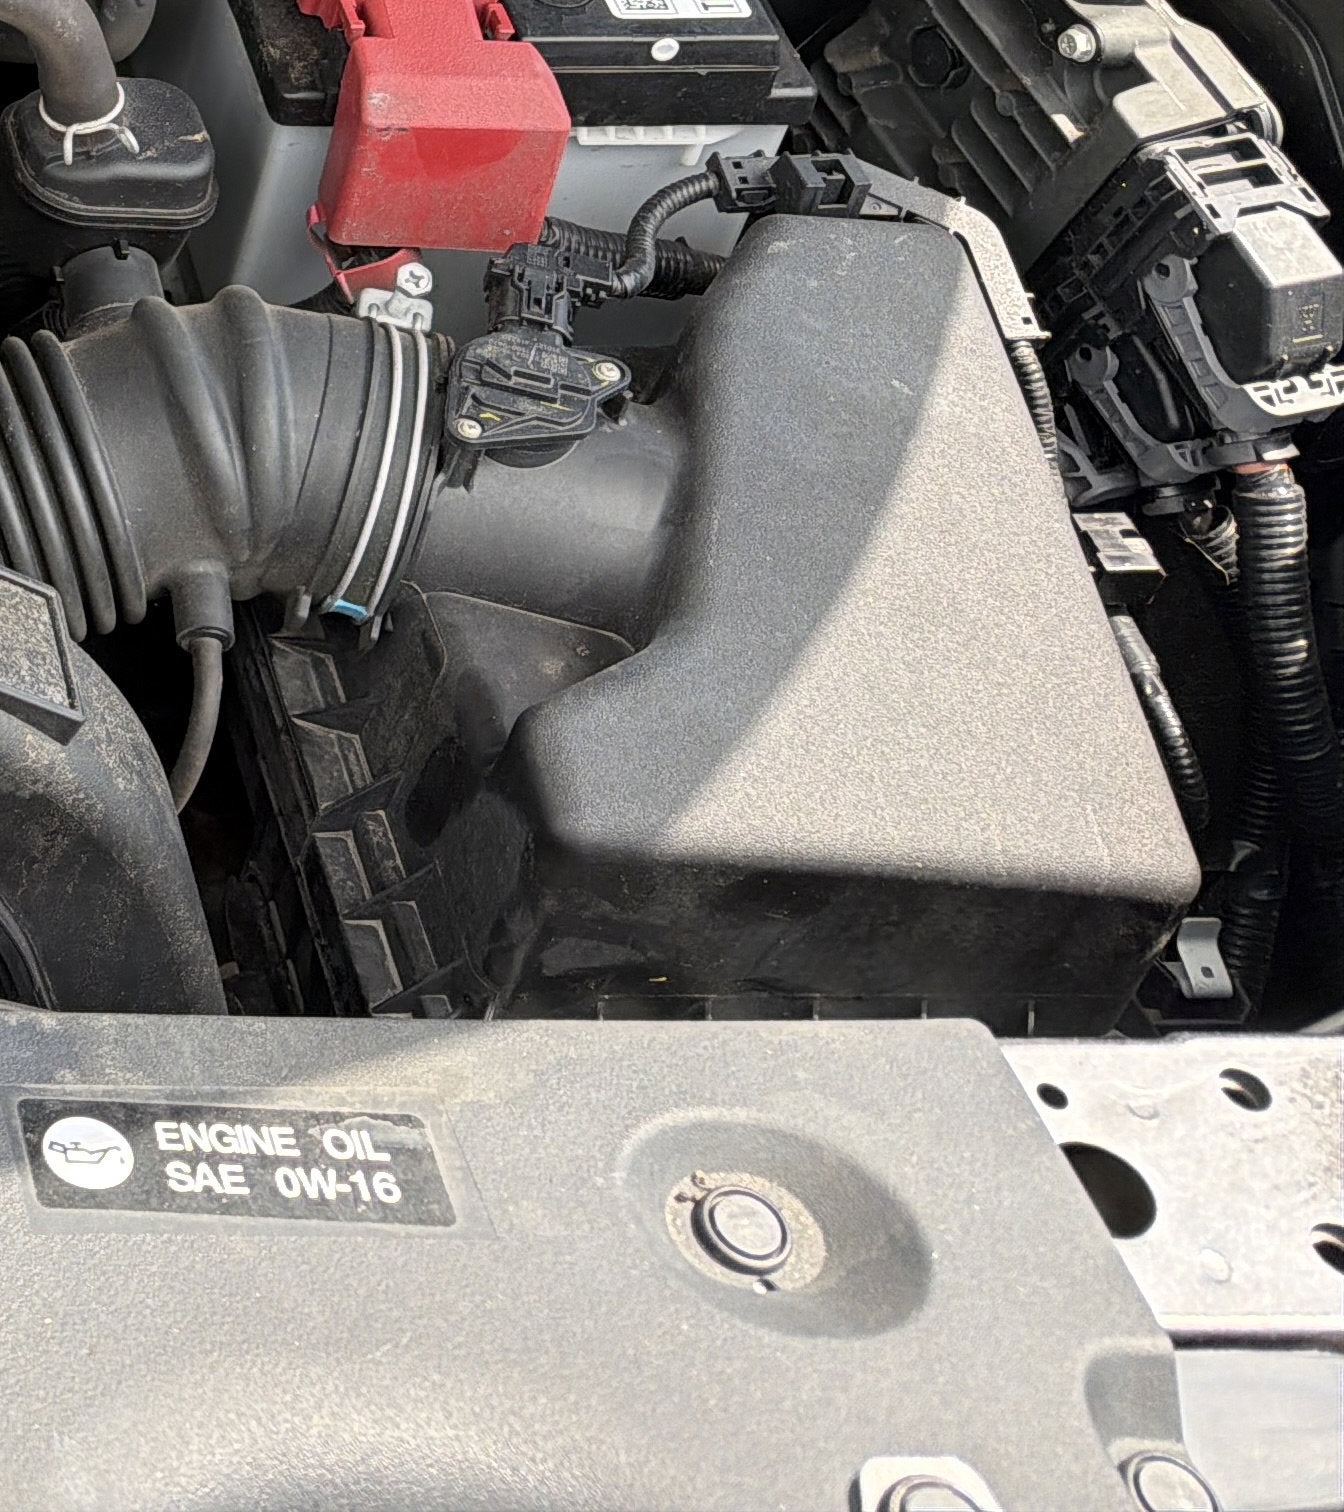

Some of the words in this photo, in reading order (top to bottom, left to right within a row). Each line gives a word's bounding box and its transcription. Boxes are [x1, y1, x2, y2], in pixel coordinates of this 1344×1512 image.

[154, 1121, 302, 1157] ENGINE
[321, 1128, 392, 1162] OIL
[165, 1160, 251, 1195] SAE
[275, 1165, 403, 1205] 0W-16
